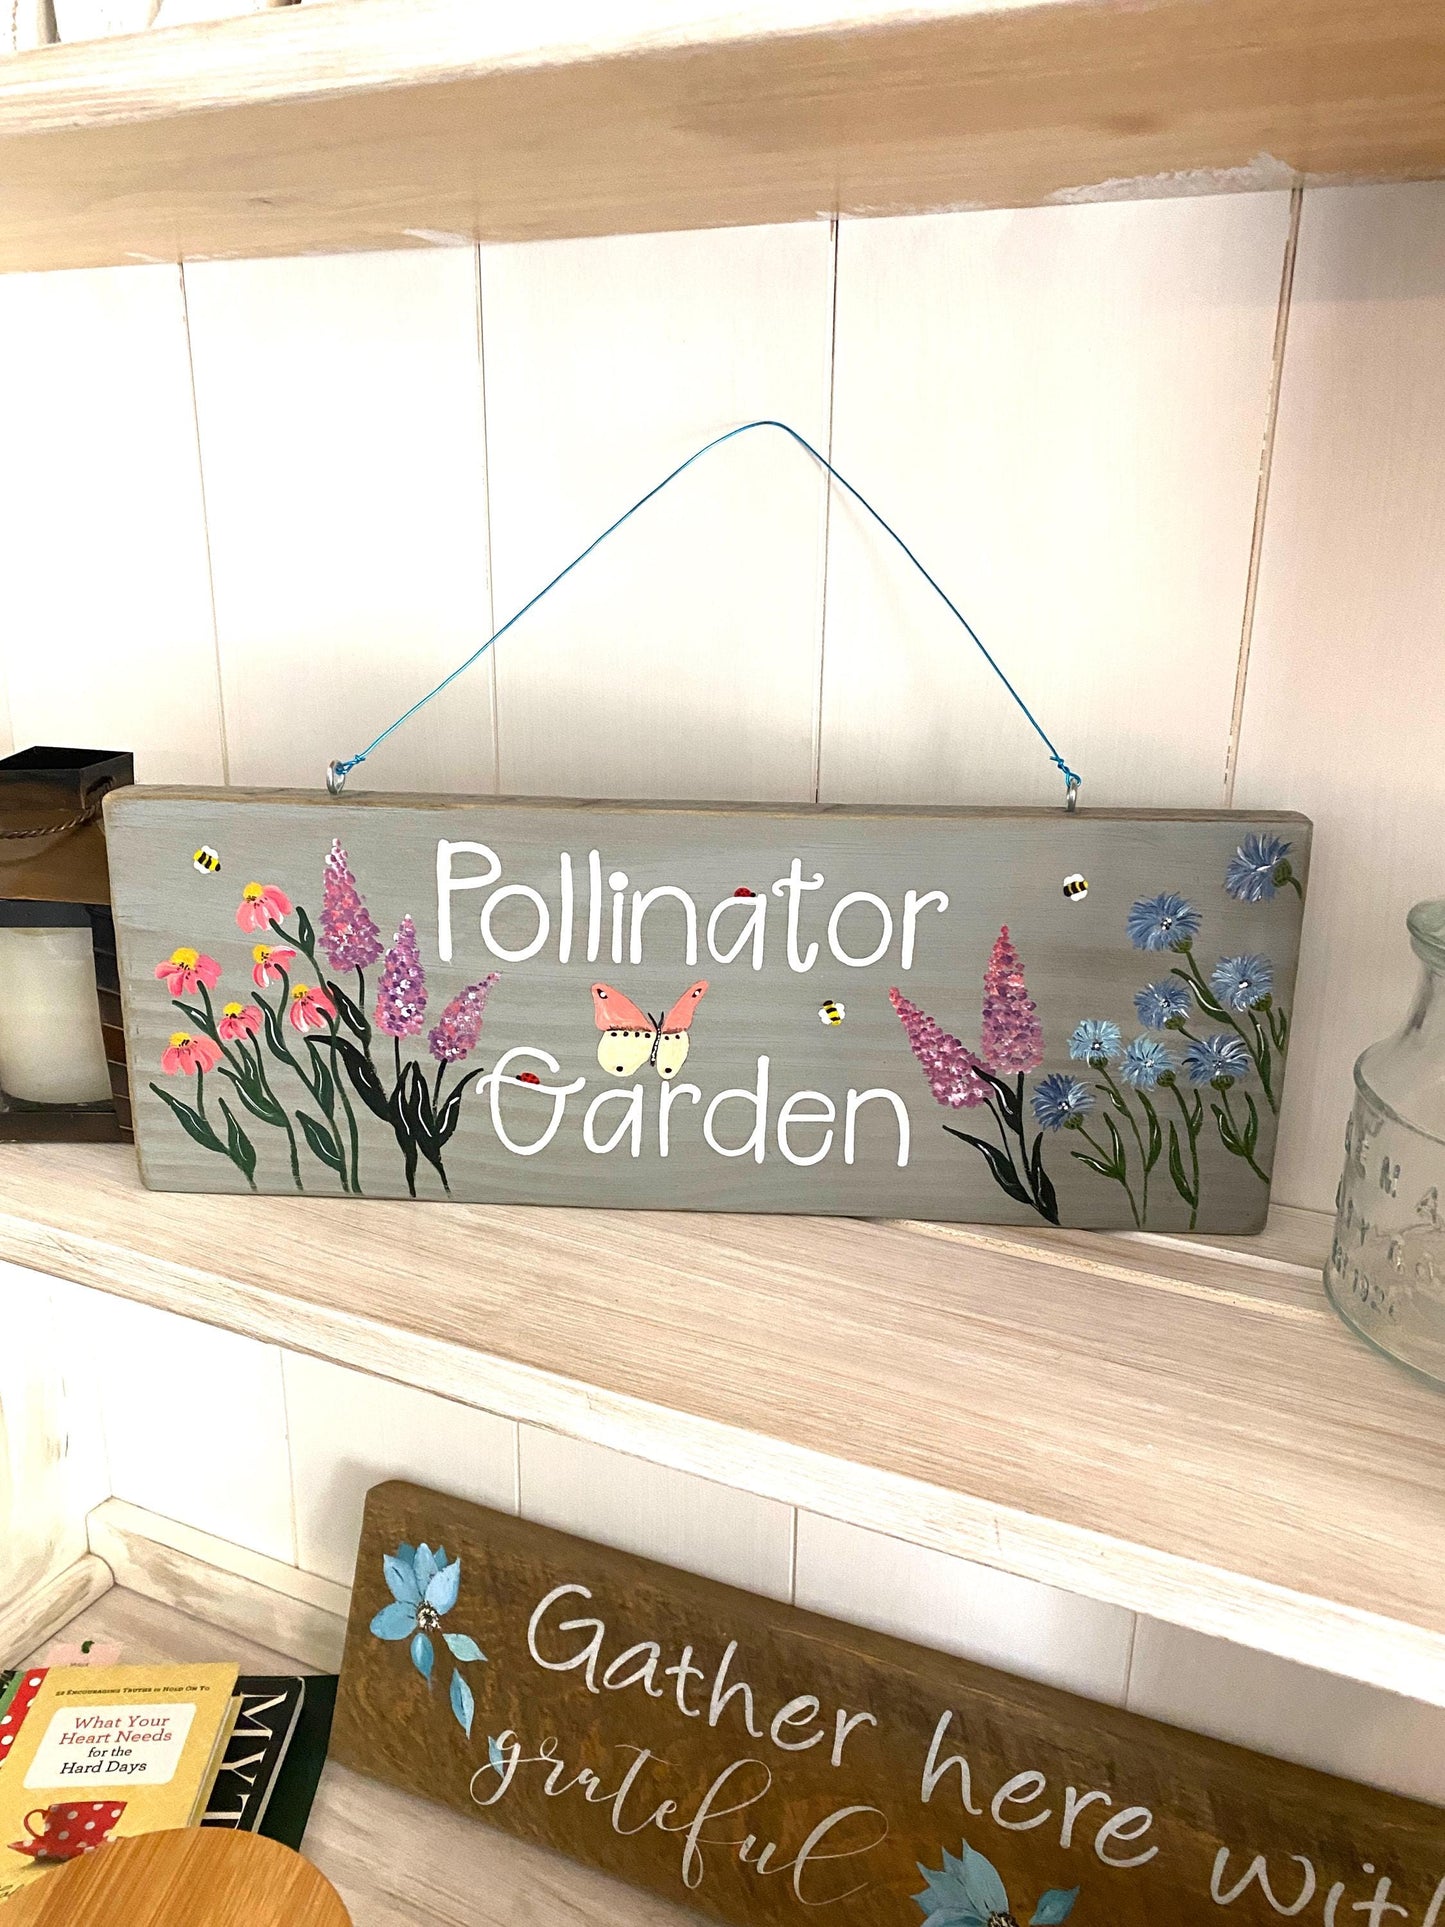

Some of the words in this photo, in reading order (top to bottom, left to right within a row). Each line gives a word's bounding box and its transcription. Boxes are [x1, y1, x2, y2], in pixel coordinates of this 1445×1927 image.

[436, 838, 949, 973] Pollinator
[475, 1046, 910, 1167] Garden
[58, 1731, 111, 1745] Heart
[116, 1728, 173, 1744] Needs
[75, 1715, 122, 1729] What
[128, 1715, 171, 1728] Your
[88, 1746, 108, 1758] for
[111, 1746, 132, 1757] the
[527, 1583, 878, 1767] Gather
[920, 1709, 1160, 1868] here
[60, 1760, 104, 1775] Hard
[105, 1760, 148, 1775] Days
[469, 1729, 889, 1906] grateful
